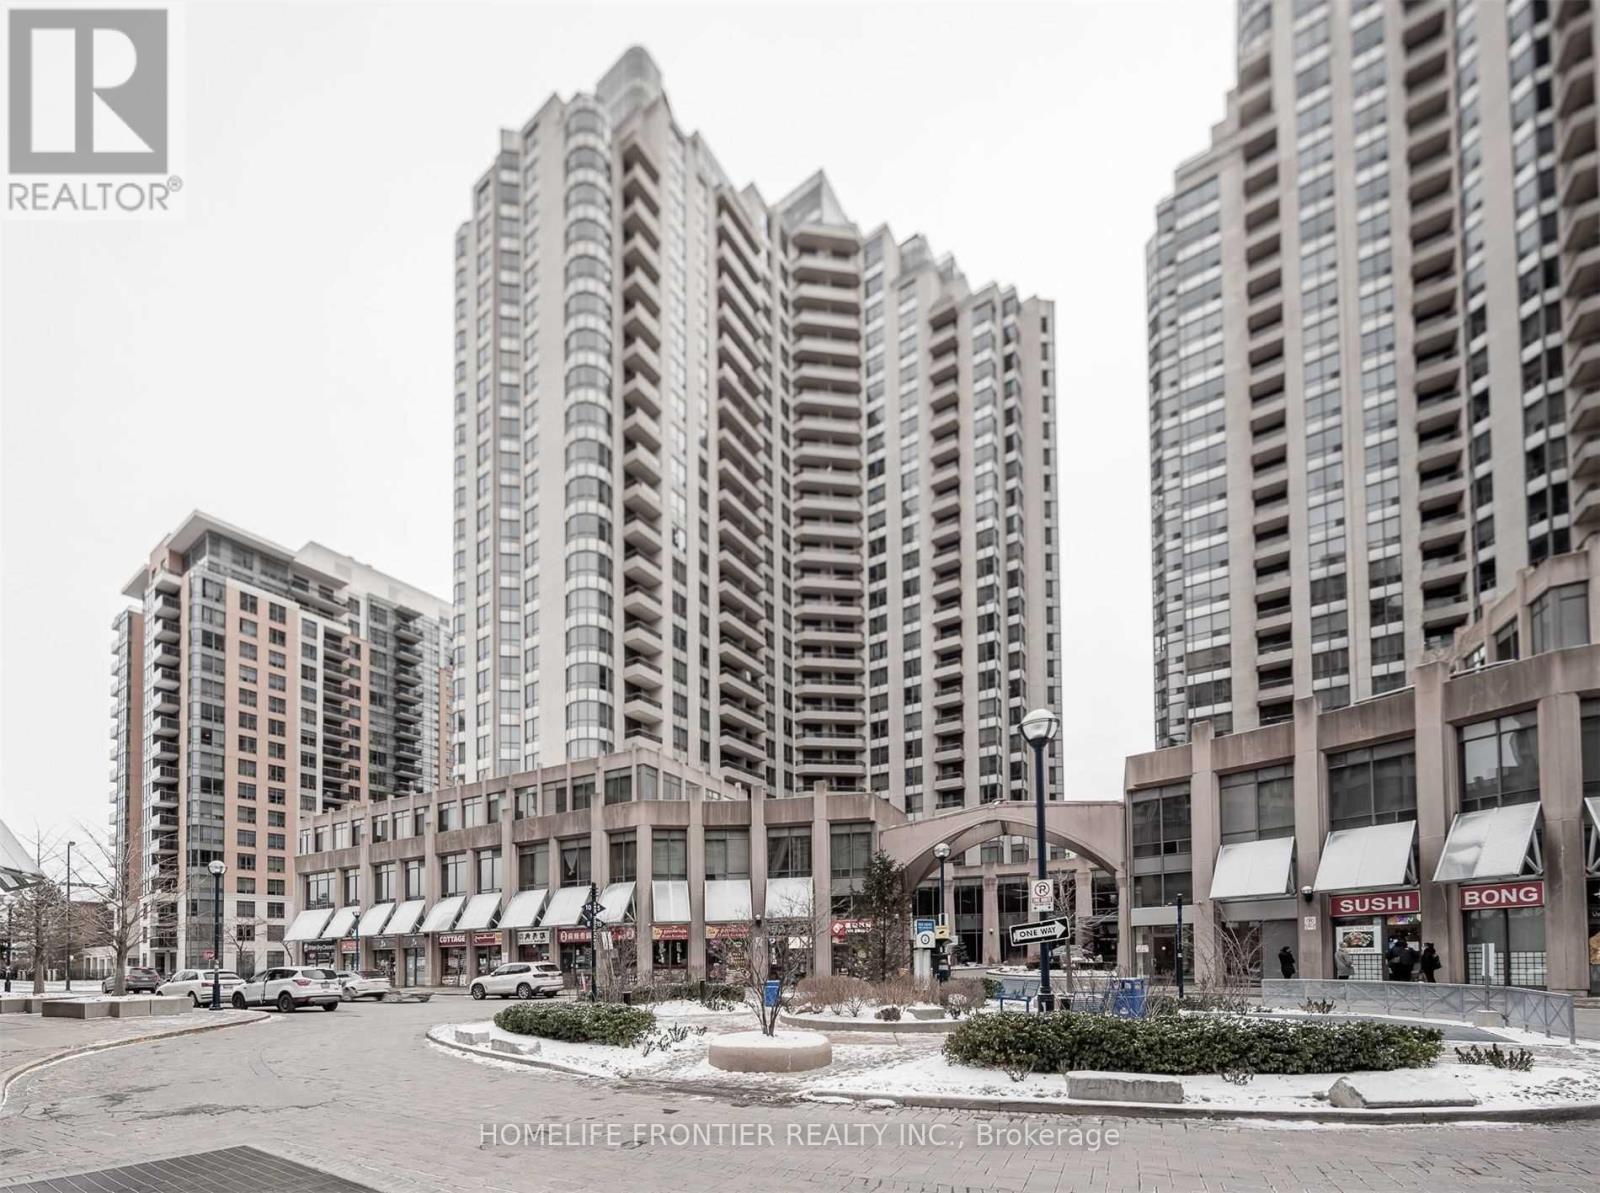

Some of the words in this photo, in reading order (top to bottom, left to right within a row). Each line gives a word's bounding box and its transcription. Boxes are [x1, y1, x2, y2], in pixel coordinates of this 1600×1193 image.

[1464, 886, 1538, 906] BONG
[1339, 895, 1411, 913] SUSHI
[439, 935, 466, 944] COTTAGE
[1019, 929, 1038, 938] ONE
[1040, 926, 1057, 935] WAY
